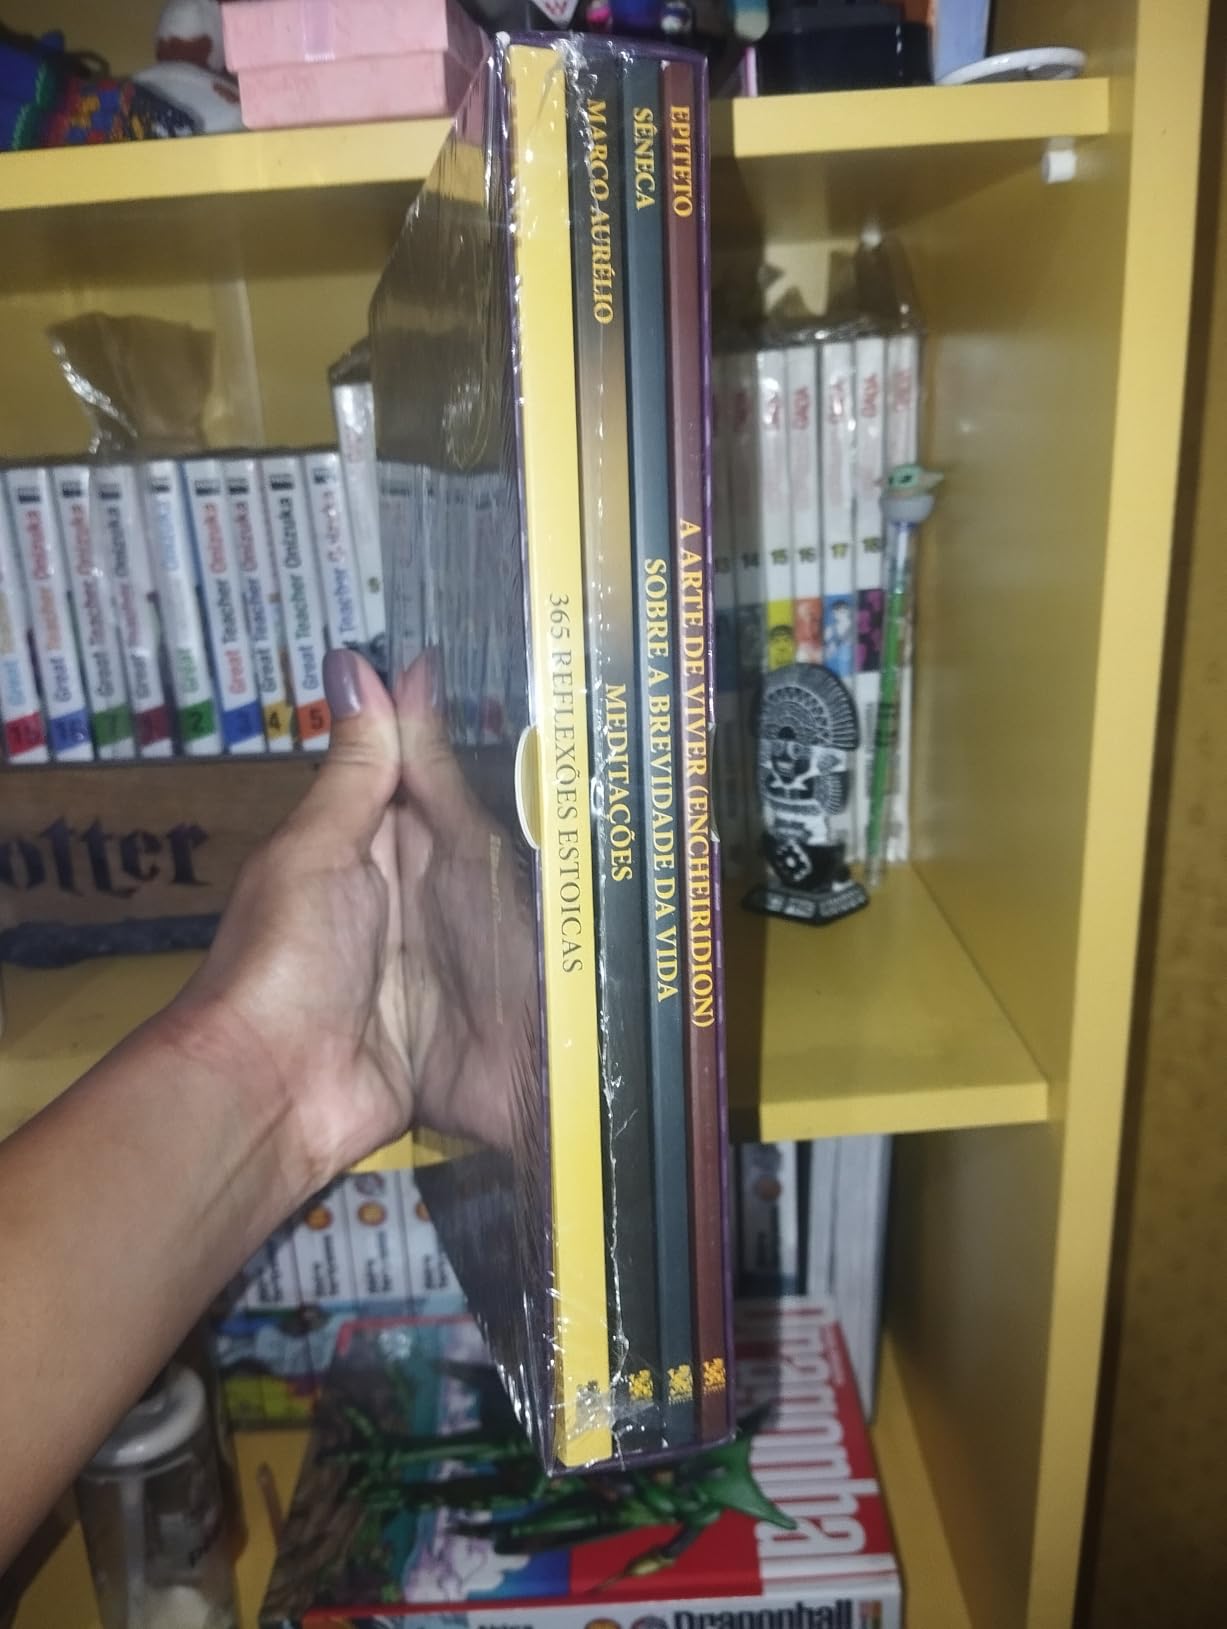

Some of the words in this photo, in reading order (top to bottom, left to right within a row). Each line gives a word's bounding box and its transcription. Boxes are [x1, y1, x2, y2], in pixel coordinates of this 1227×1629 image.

[587, 99, 610, 202] MARCO
[632, 107, 659, 209] SÊNECA
[670, 106, 693, 218] EPITETO
[590, 205, 616, 324] AURÉLIO
[279, 496, 302, 569] Onizuka
[679, 518, 702, 539] A
[288, 575, 312, 640] Teacher
[549, 592, 571, 640] 365
[644, 558, 670, 659] SOBRE
[680, 549, 704, 629] ARTE
[297, 644, 321, 690] Great
[647, 668, 670, 687] A
[682, 633, 706, 678] DE
[551, 650, 581, 820] REFLEXÕES
[685, 681, 708, 777] VIVER
[605, 683, 636, 882] MEDITAÇÕES
[649, 695, 676, 871] BREVIDADE
[558, 829, 584, 974] ESTOICAS
[653, 876, 677, 920] DA
[687, 785, 716, 1028] (ENCHEIRIDION)
[655, 924, 680, 1003] VIDA
